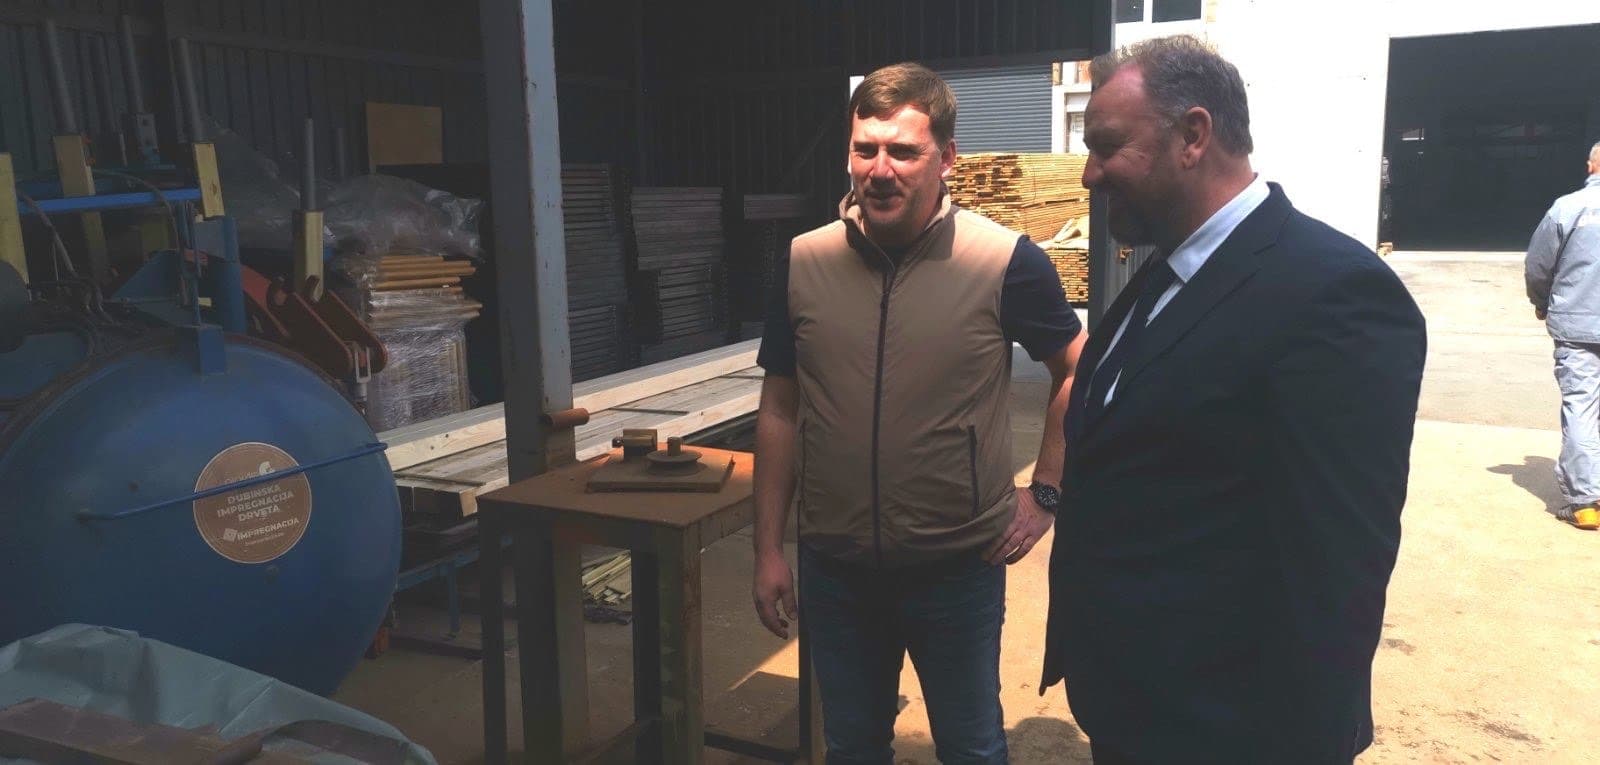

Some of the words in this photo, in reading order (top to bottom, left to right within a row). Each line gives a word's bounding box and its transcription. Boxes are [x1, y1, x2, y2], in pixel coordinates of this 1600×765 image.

[217, 490, 294, 518] IMPREGNACIJA
[227, 485, 281, 504] DUBINSKA
[239, 505, 280, 521] DRVETA
[237, 518, 300, 540] IMPREGNACIJA
